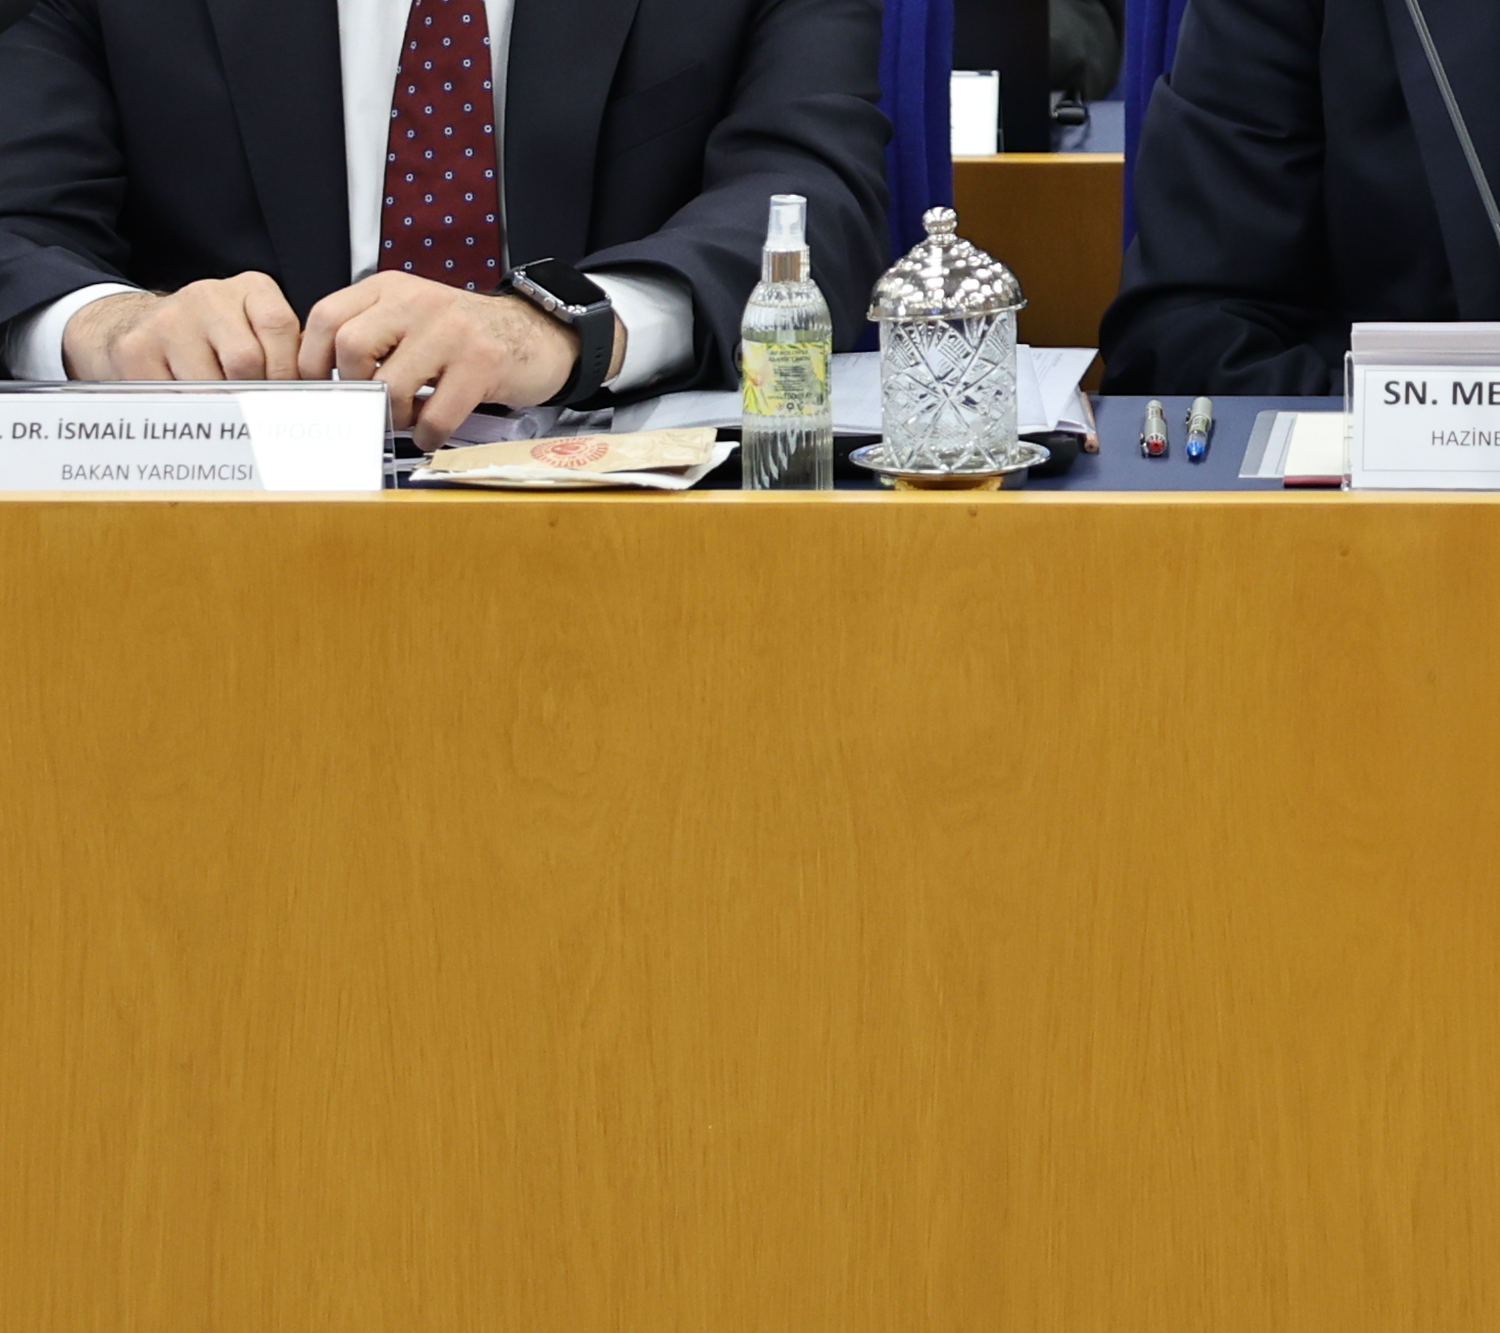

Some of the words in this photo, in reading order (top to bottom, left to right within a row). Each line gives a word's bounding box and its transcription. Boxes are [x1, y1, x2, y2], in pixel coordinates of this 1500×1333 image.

[1384, 380, 1438, 406] SN.
[11, 422, 49, 440] DR.
[57, 418, 136, 440] İSMAİL
[143, 418, 212, 440] İLHAN
[61, 463, 130, 481] BAKAN
[136, 463, 254, 481] YARDIMCISI
